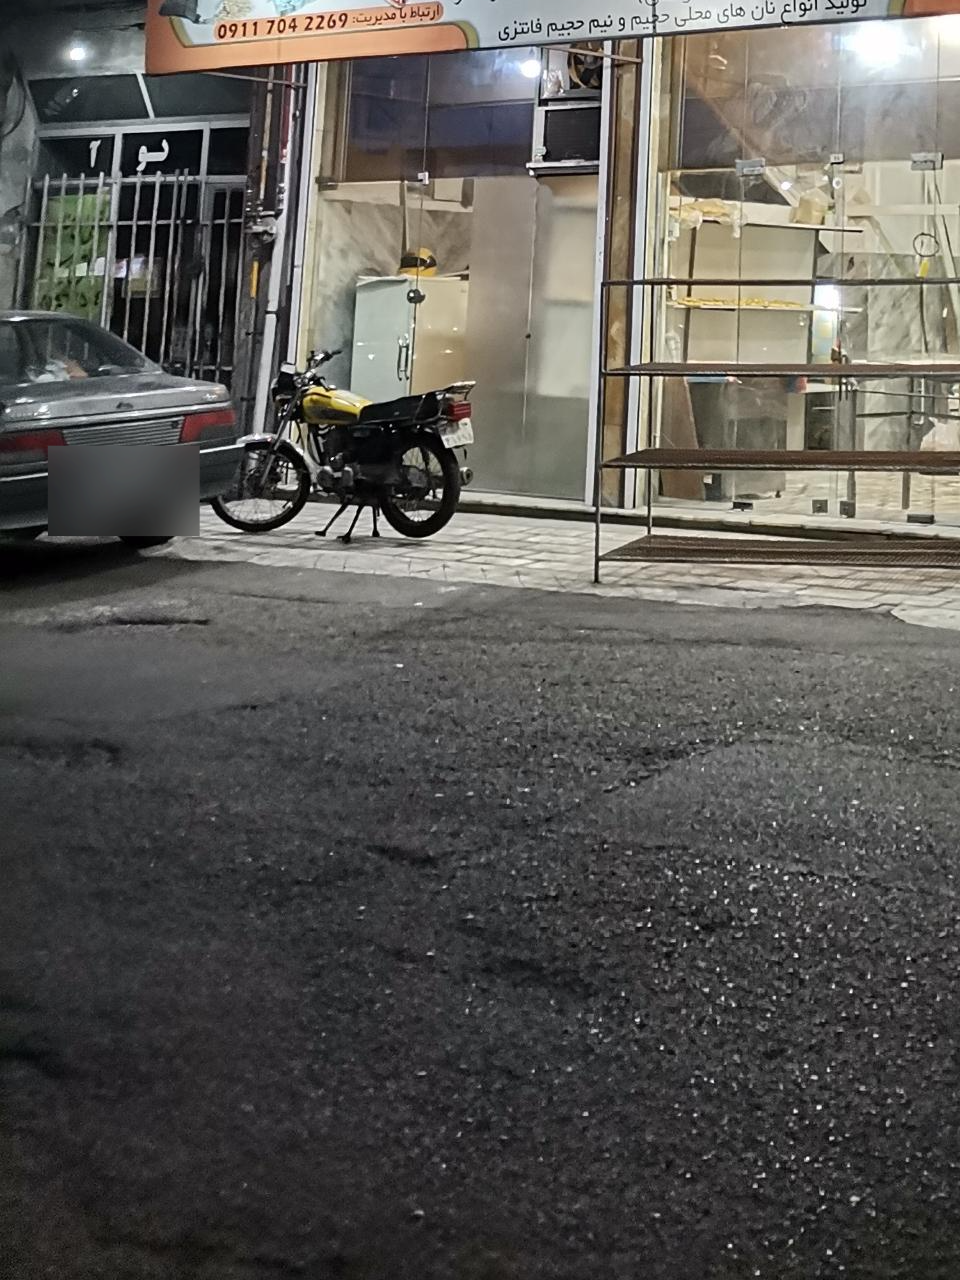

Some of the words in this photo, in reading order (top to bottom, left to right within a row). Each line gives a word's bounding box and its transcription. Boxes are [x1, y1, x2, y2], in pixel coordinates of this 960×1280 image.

[399, 7, 407, 23] با
[409, 6, 440, 22] ارتباط
[675, 7, 712, 27] محلی
[717, 3, 746, 24] های
[751, 0, 775, 20] نان
[217, 21, 259, 39] 0911
[266, 18, 298, 34] 704
[304, 13, 348, 31] 2269
[498, 18, 542, 41] فانتزی
[546, 21, 585, 37] حجیم
[589, 14, 613, 34] نیم
[618, 16, 626, 31] و
[630, 13, 670, 31] حجیم
